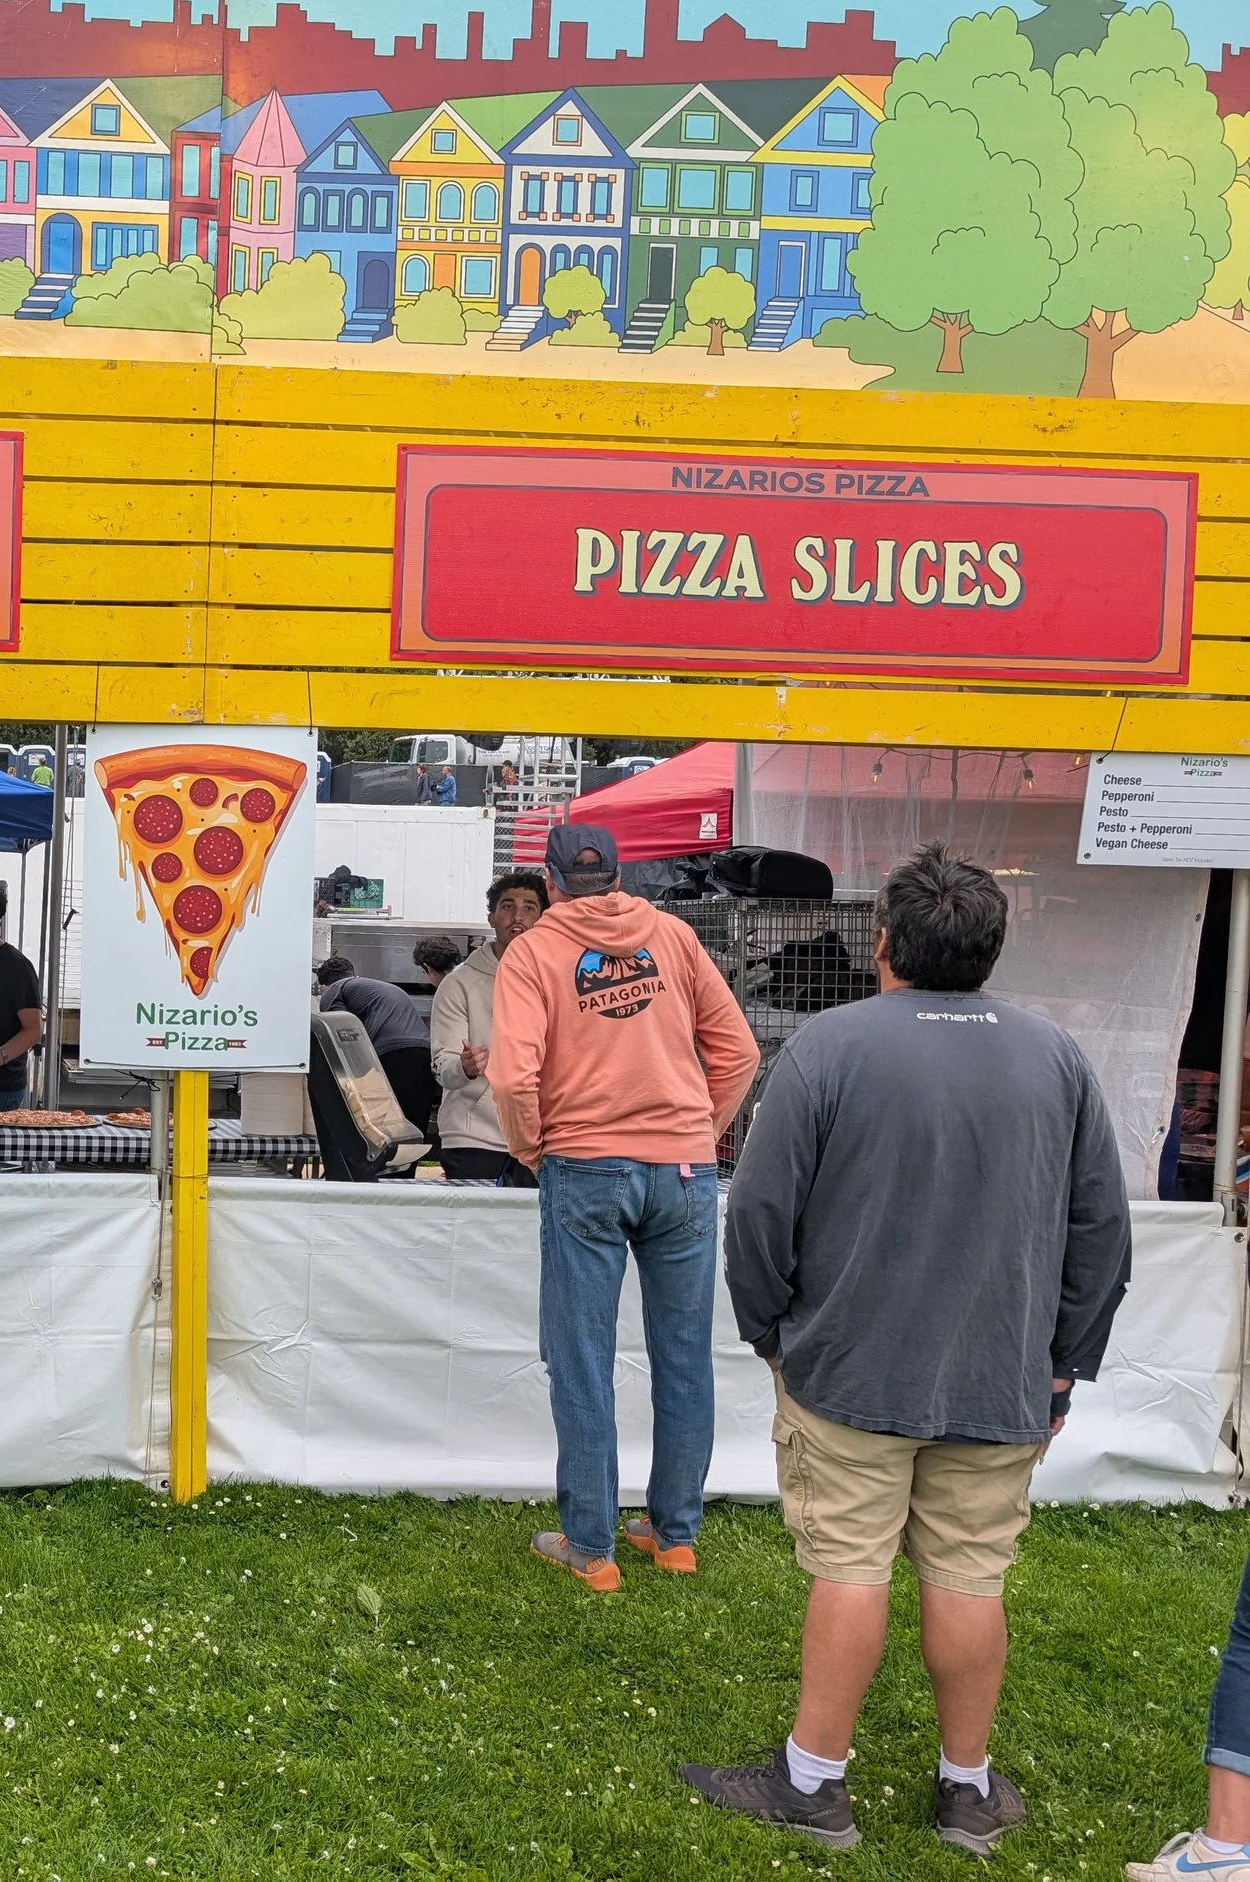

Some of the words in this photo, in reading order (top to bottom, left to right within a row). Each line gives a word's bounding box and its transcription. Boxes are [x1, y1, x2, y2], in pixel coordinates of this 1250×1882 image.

[671, 467, 825, 494] NIZARIOS
[835, 474, 930, 497] PIZZA
[573, 527, 767, 602] PIZZA
[790, 535, 1025, 609] SLICES
[1181, 757, 1228, 767] Nizario's
[1191, 768, 1215, 777] Pizza
[1103, 774, 1142, 786] Cheese
[1101, 790, 1155, 803] Pepperoni
[1099, 806, 1128, 817] Pesto
[1097, 822, 1126, 833] Pesto
[1130, 825, 1137, 833] +
[1140, 822, 1193, 836] Pepperoni
[1095, 838, 1127, 850] Vegan
[1131, 838, 1168, 850] Cheese
[578, 980, 666, 1013] PATAGONIA
[136, 1002, 258, 1027] Nizario's
[615, 1003, 638, 1017] 1973
[916, 1012, 984, 1023] carhartt
[164, 1031, 228, 1051] Pizza
